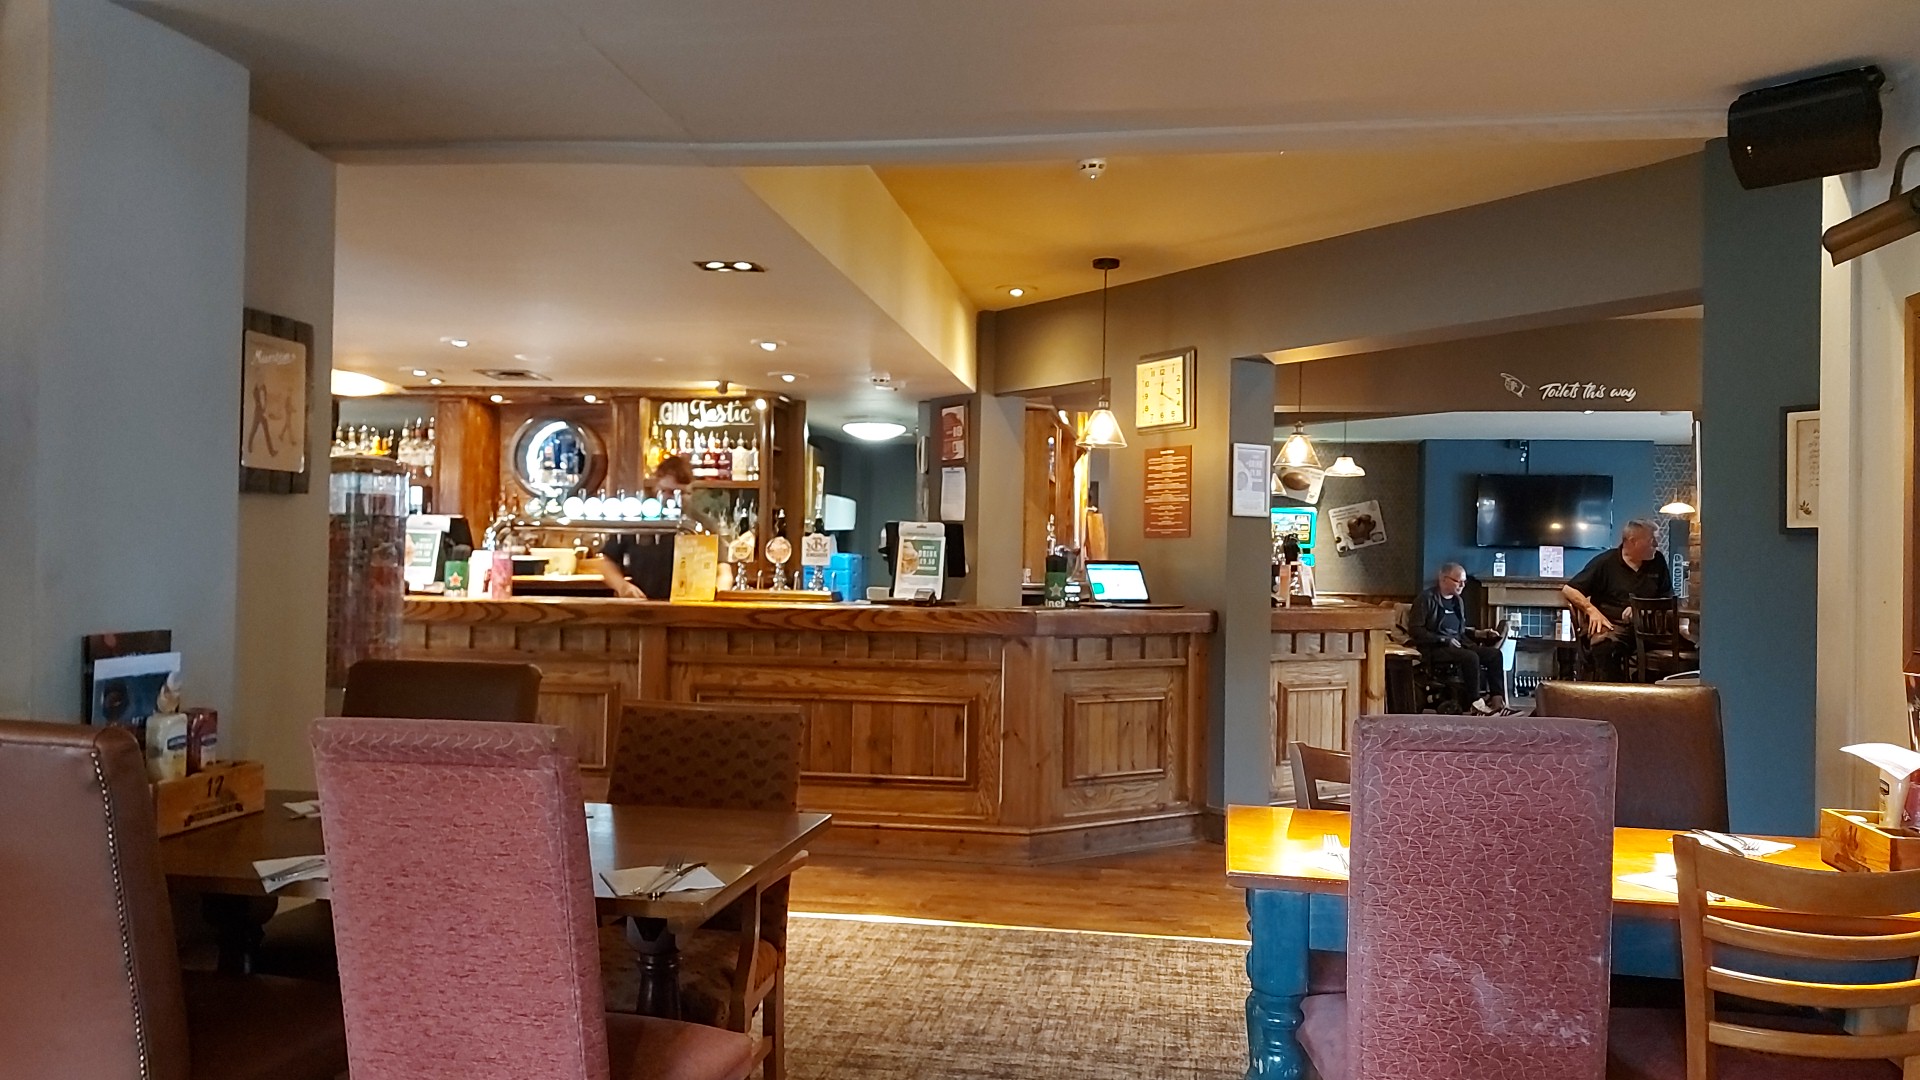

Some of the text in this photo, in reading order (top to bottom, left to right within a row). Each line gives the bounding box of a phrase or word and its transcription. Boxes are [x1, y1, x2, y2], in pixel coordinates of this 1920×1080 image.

[1539, 382, 1637, 402] Toilets this way
[660, 401, 689, 426] GIN
